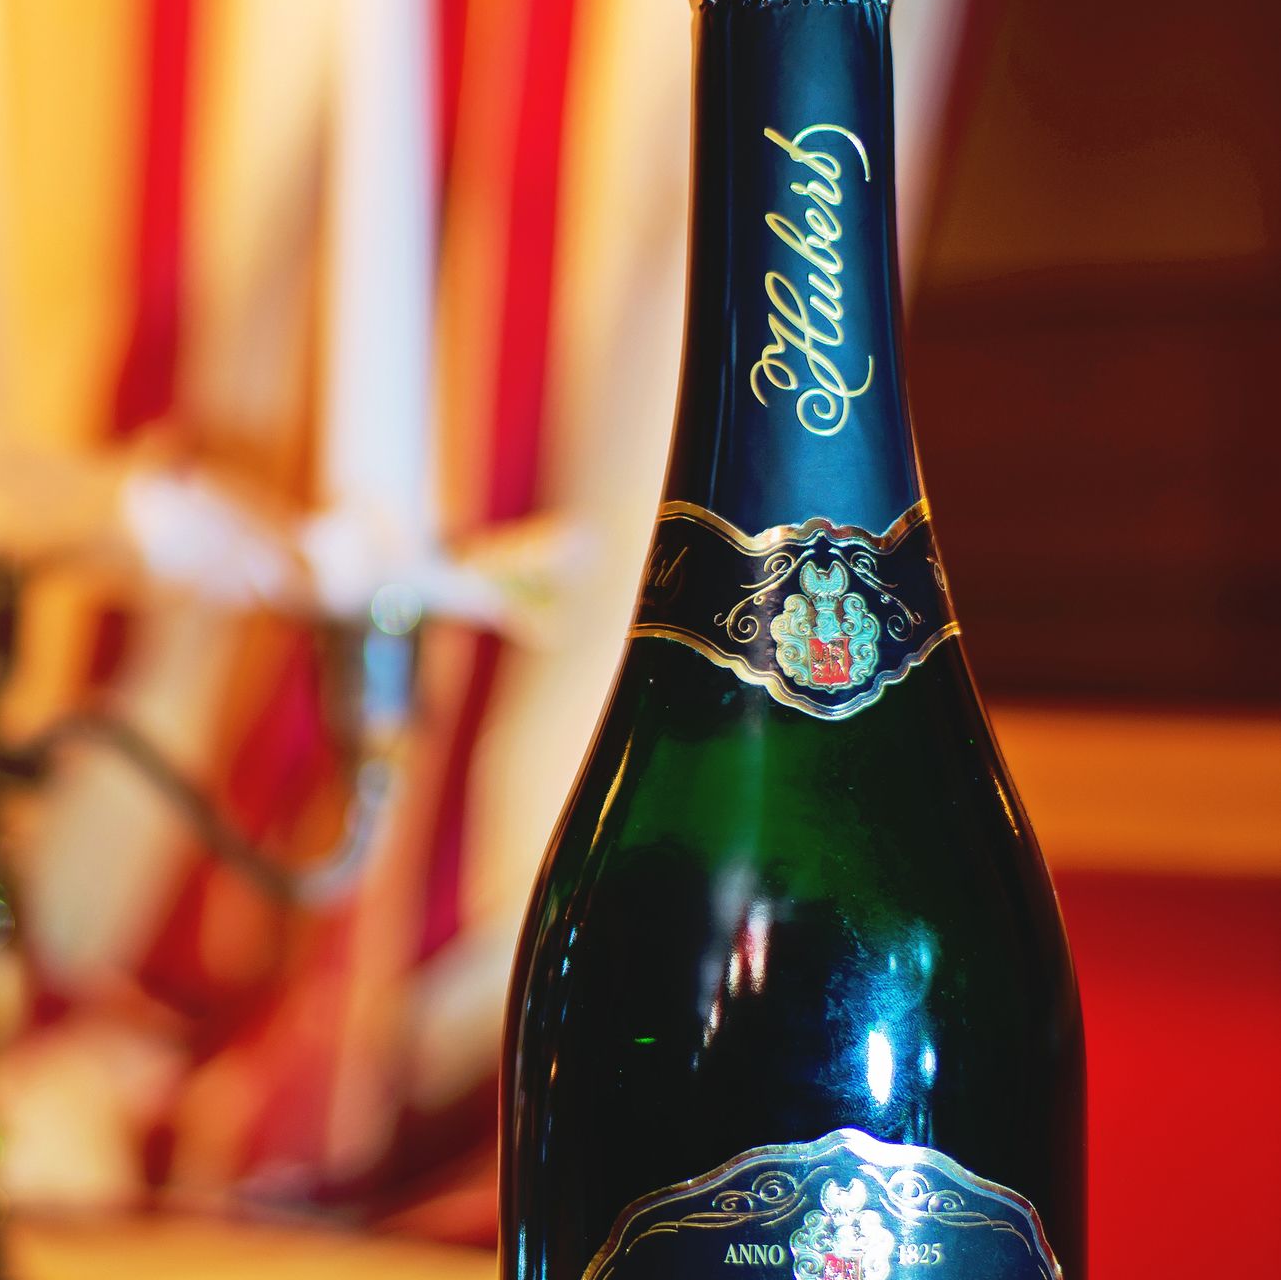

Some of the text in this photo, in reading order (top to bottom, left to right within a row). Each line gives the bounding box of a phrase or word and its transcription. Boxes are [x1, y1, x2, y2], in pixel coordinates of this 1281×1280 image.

[750, 123, 875, 436] Hubert
[724, 1242, 943, 1266] ANNO 1825
